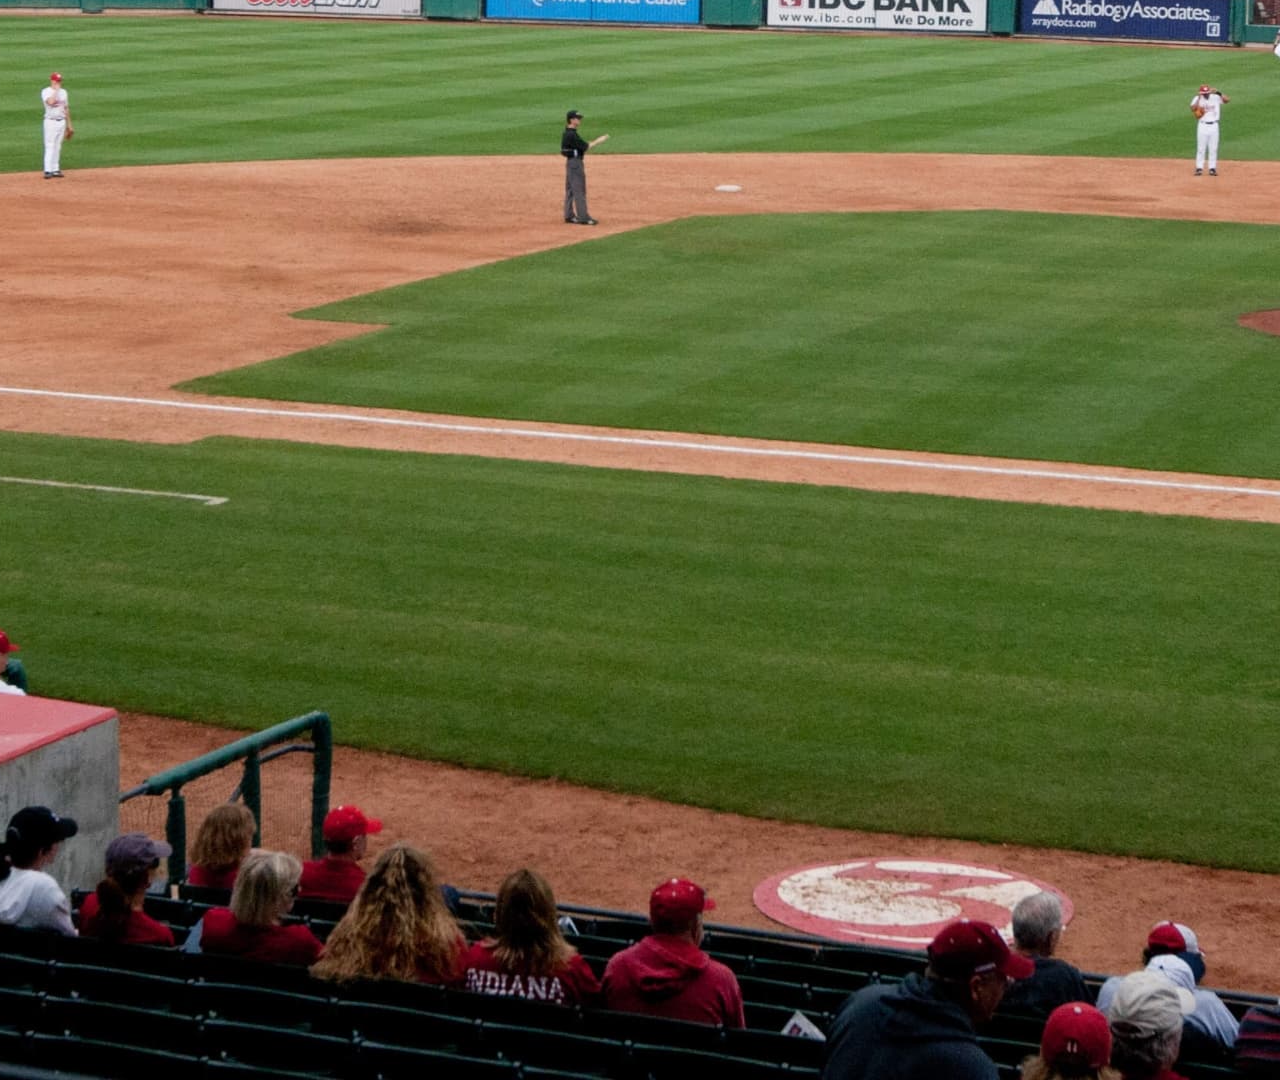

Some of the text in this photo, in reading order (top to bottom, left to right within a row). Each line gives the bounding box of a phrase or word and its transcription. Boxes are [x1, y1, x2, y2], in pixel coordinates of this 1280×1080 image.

[1131, 0, 1210, 22] Associates
[779, 13, 875, 24] www.ibc.com
[893, 14, 973, 27] We Do More
[1032, 17, 1097, 29] xraydocs.com
